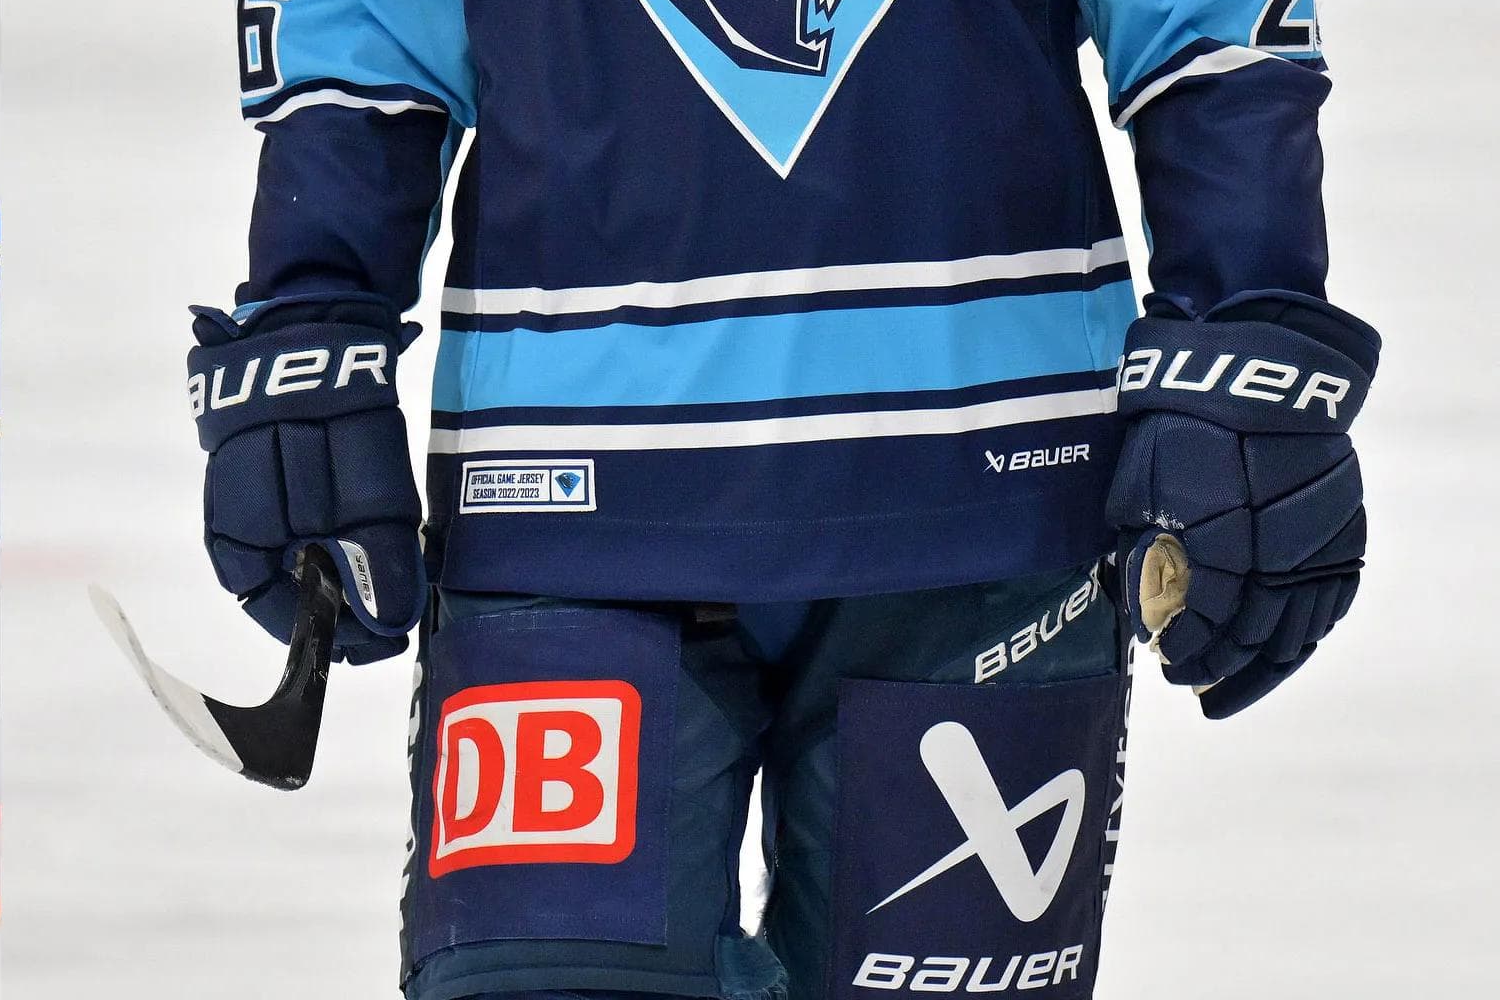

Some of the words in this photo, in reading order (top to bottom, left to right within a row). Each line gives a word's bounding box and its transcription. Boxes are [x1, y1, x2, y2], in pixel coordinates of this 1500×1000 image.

[1117, 349, 1351, 419] AUER
[1008, 443, 1091, 472] BAUER
[470, 474, 495, 485] OFFICIAL
[497, 473, 516, 485] GAME
[517, 473, 544, 484] JERSEY
[473, 488, 497, 500] SEASON
[498, 487, 540, 499] 2022/2023
[442, 710, 605, 846] DB
[851, 944, 1084, 994] BAUER
